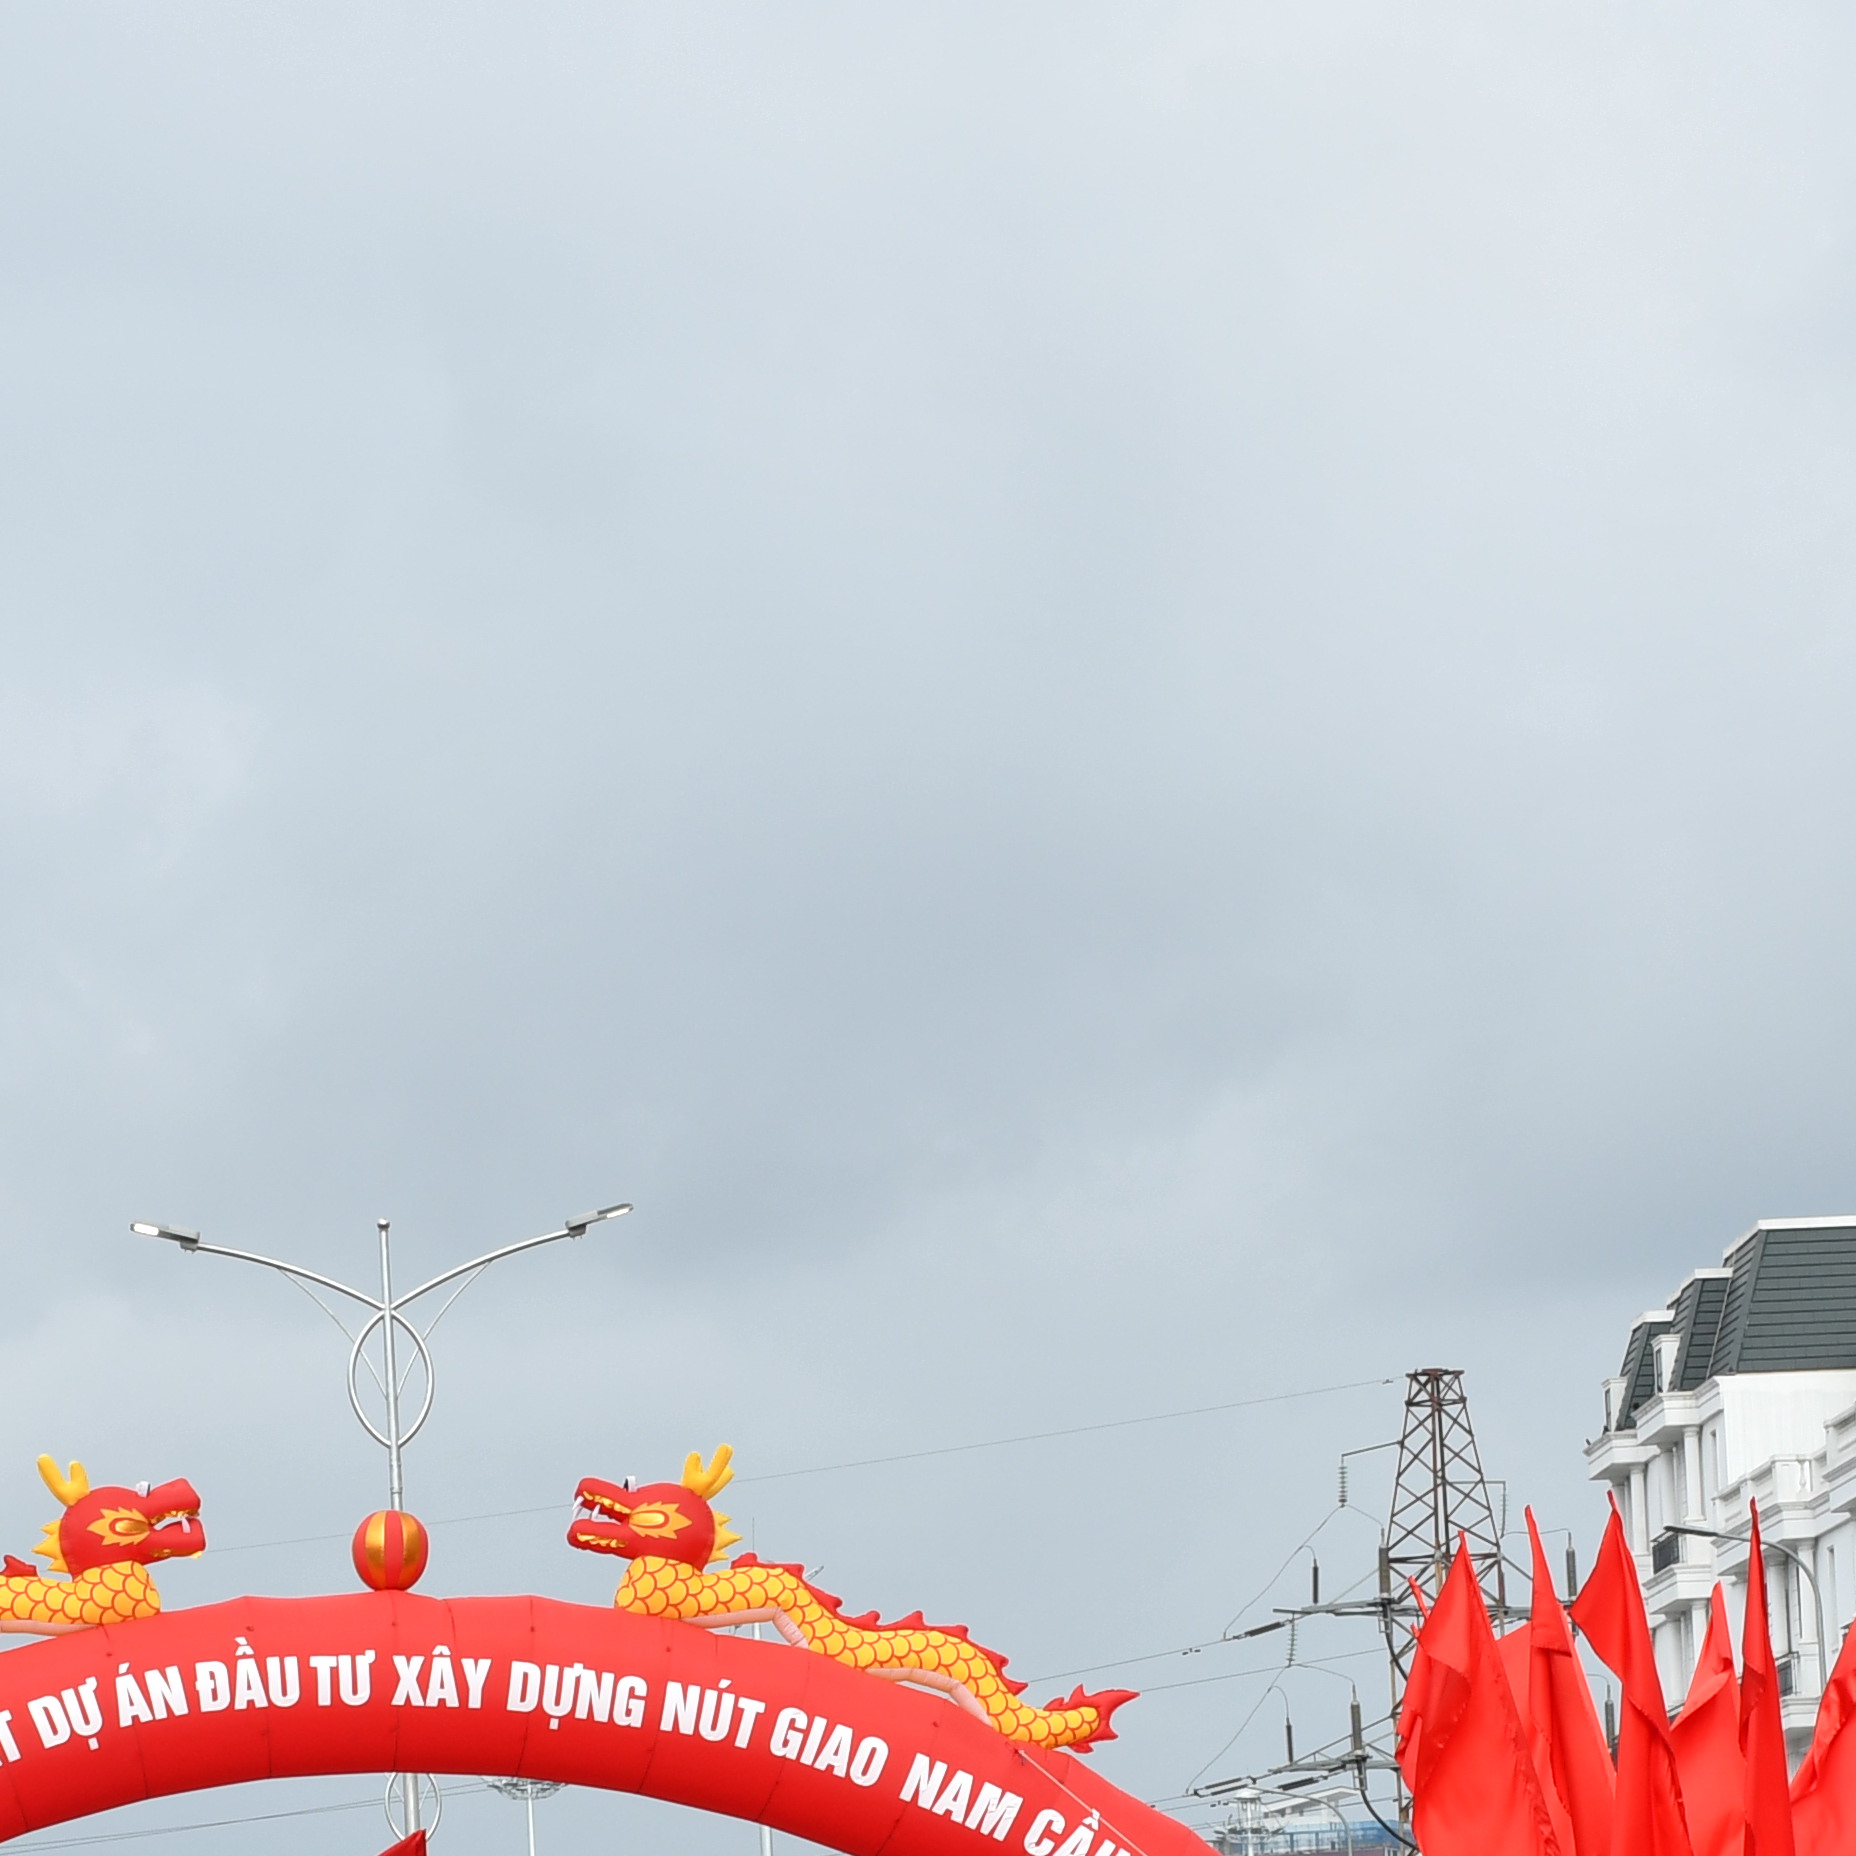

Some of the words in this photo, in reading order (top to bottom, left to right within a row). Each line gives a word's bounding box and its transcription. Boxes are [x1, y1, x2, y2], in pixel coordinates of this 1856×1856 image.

[28, 1676, 104, 1751] DỰ
[115, 1654, 189, 1728] ÁN
[194, 1636, 301, 1713] ĐẦU
[308, 1649, 377, 1707] TƯ
[391, 1645, 493, 1710] XÂY
[506, 1656, 648, 1731] DỰNG
[659, 1678, 766, 1749] NÚT
[768, 1706, 889, 1788] GIAO
[898, 1752, 1024, 1842] NAM
